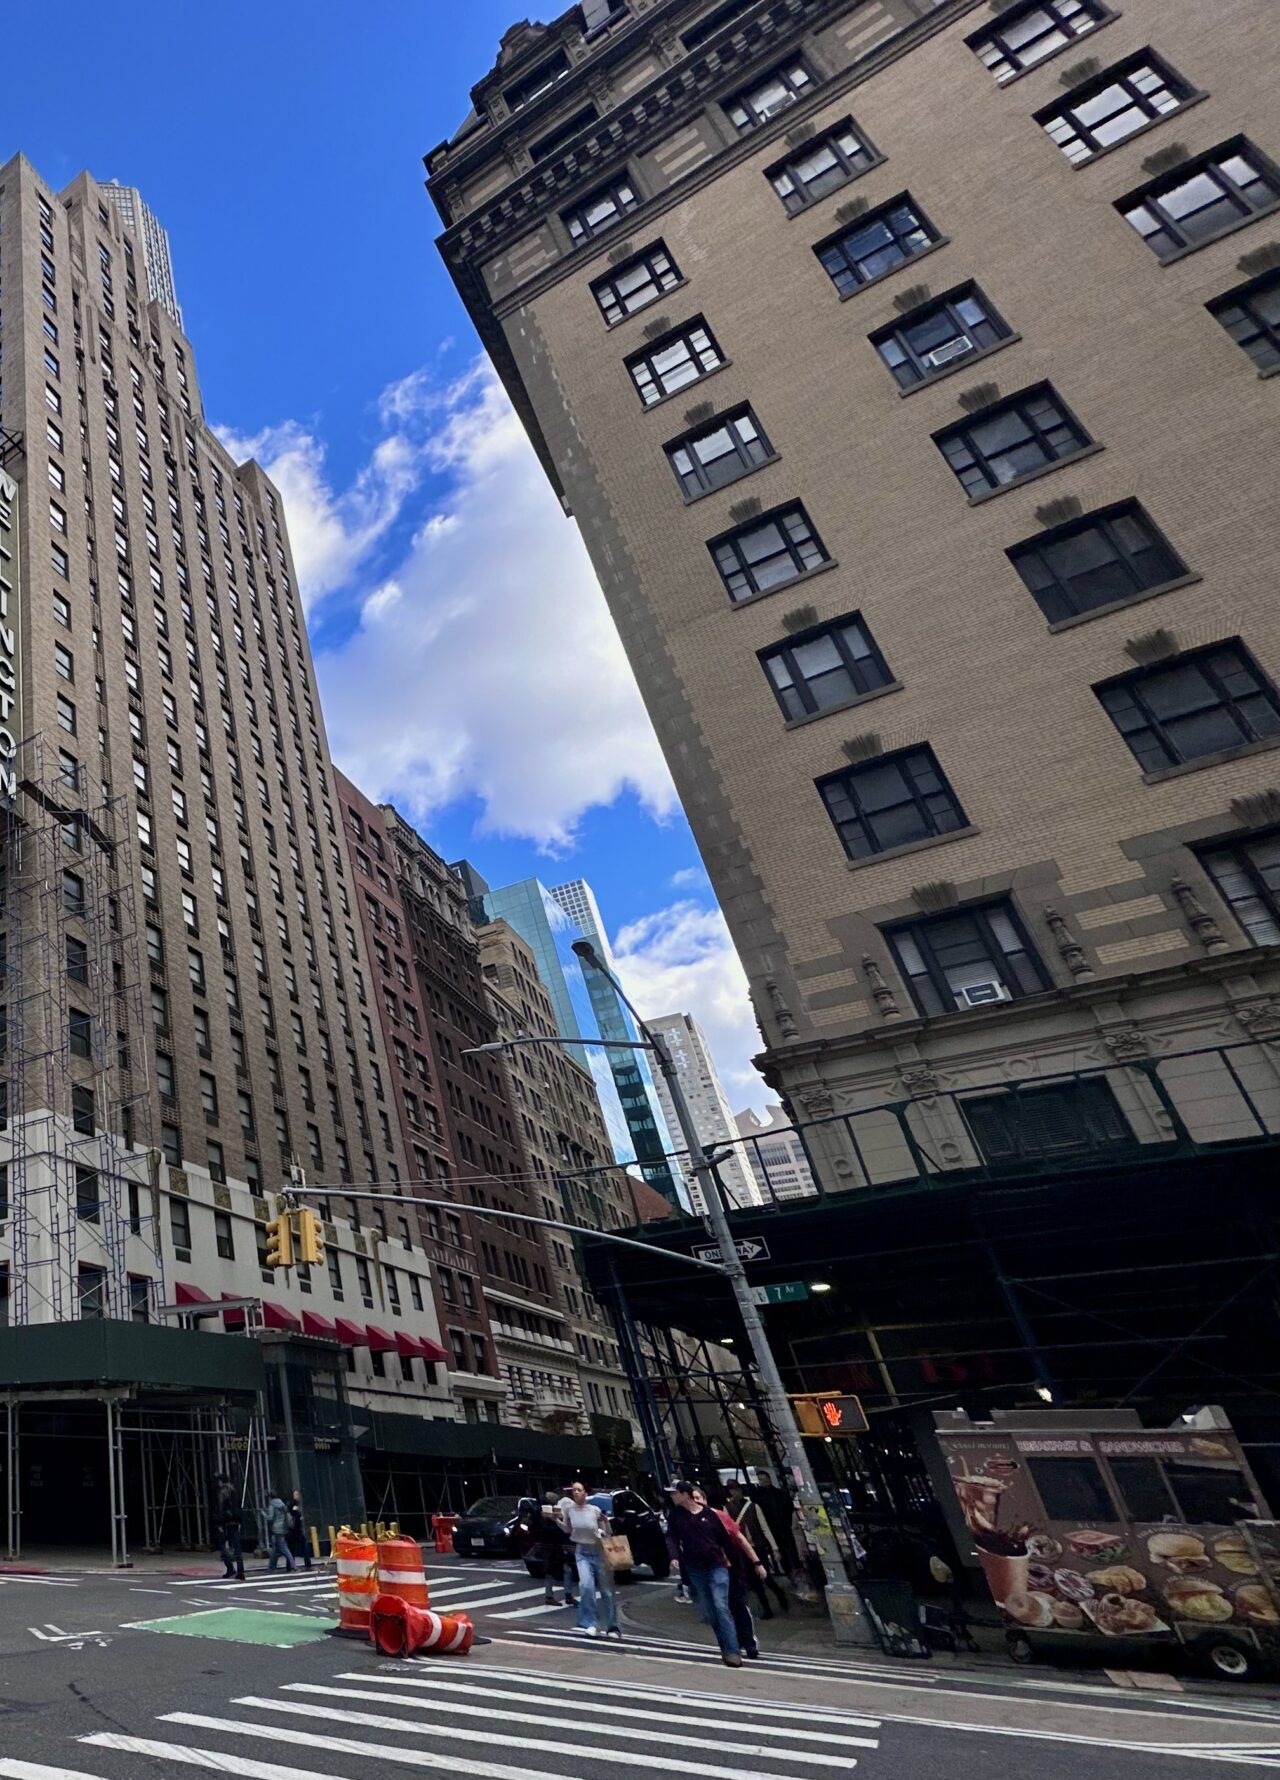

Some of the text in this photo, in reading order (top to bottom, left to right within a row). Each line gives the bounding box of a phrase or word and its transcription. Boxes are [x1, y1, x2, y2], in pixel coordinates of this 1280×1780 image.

[704, 1245, 755, 1260] ONE WAY
[773, 1287, 782, 1300] 7
